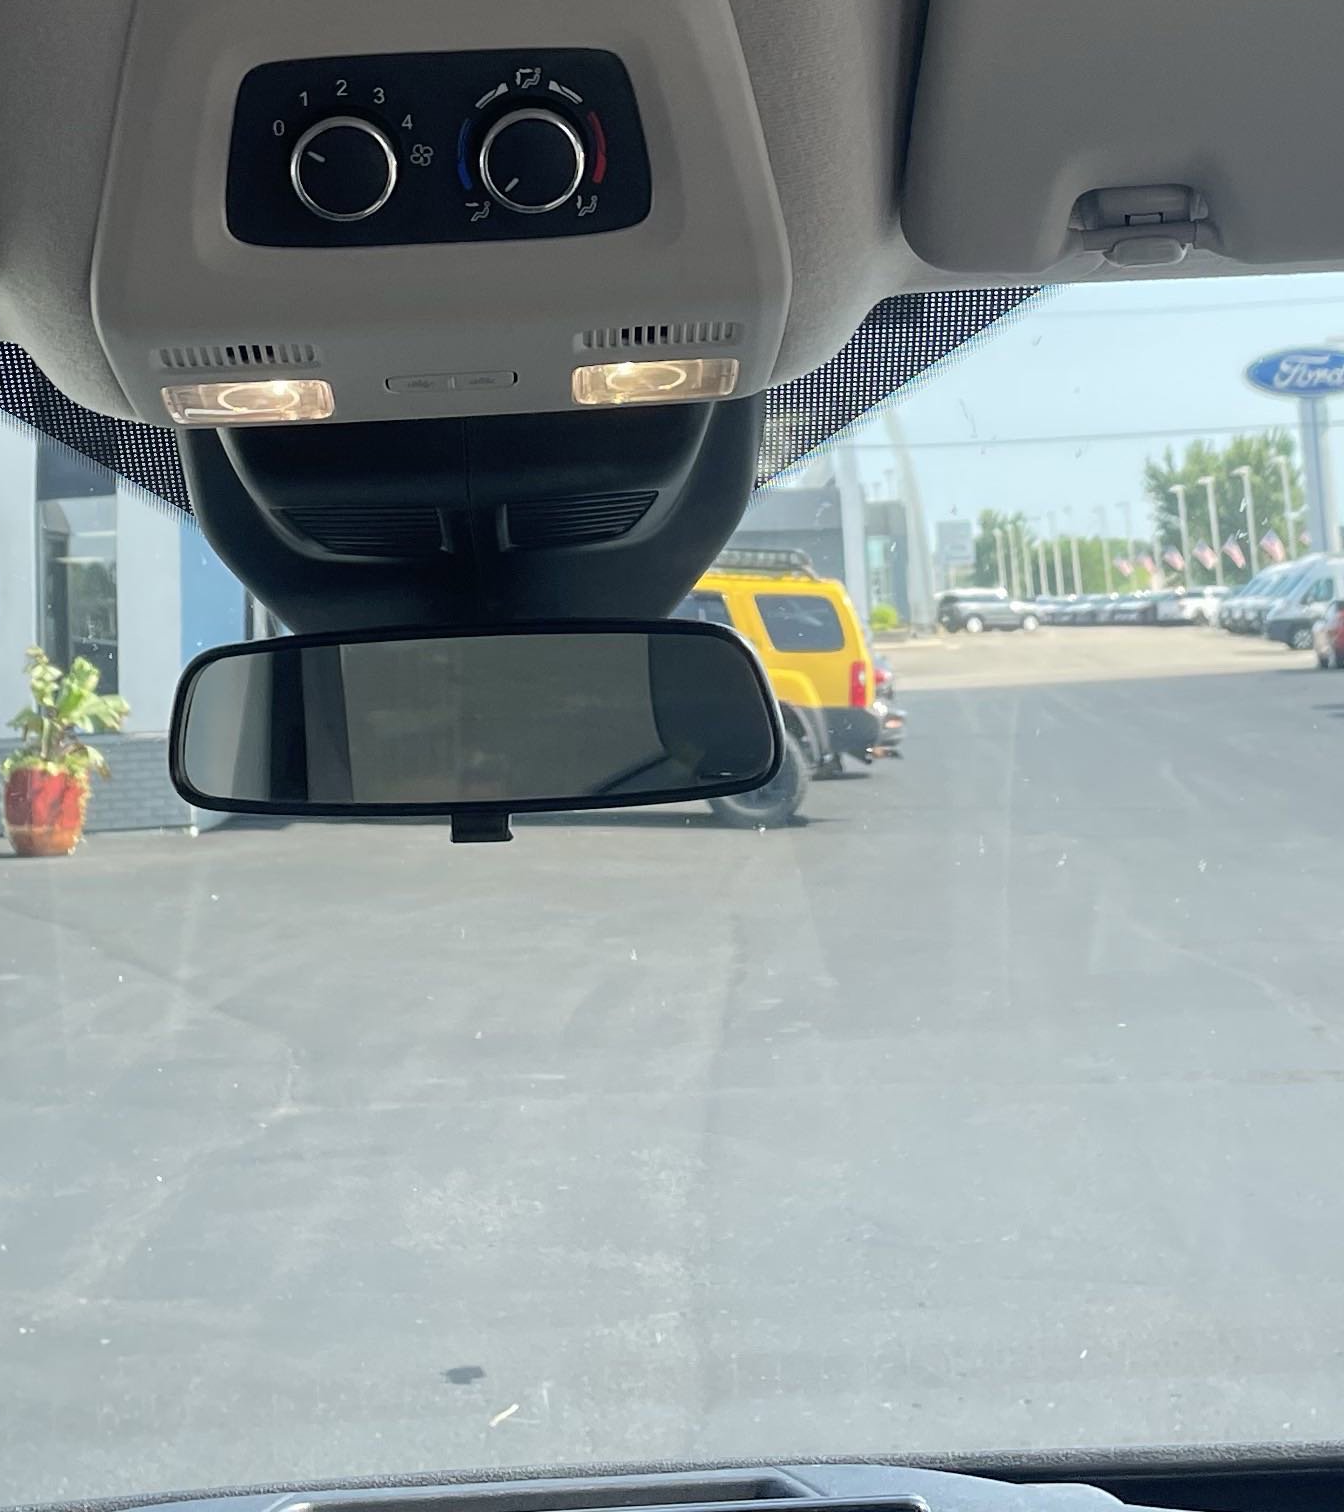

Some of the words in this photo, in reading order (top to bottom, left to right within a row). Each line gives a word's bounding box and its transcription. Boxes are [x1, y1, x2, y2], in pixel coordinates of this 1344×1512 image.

[273, 120, 285, 136] 0
[299, 91, 308, 106] 1
[336, 79, 348, 96] 2
[373, 88, 385, 104] 3
[401, 114, 413, 130] 4
